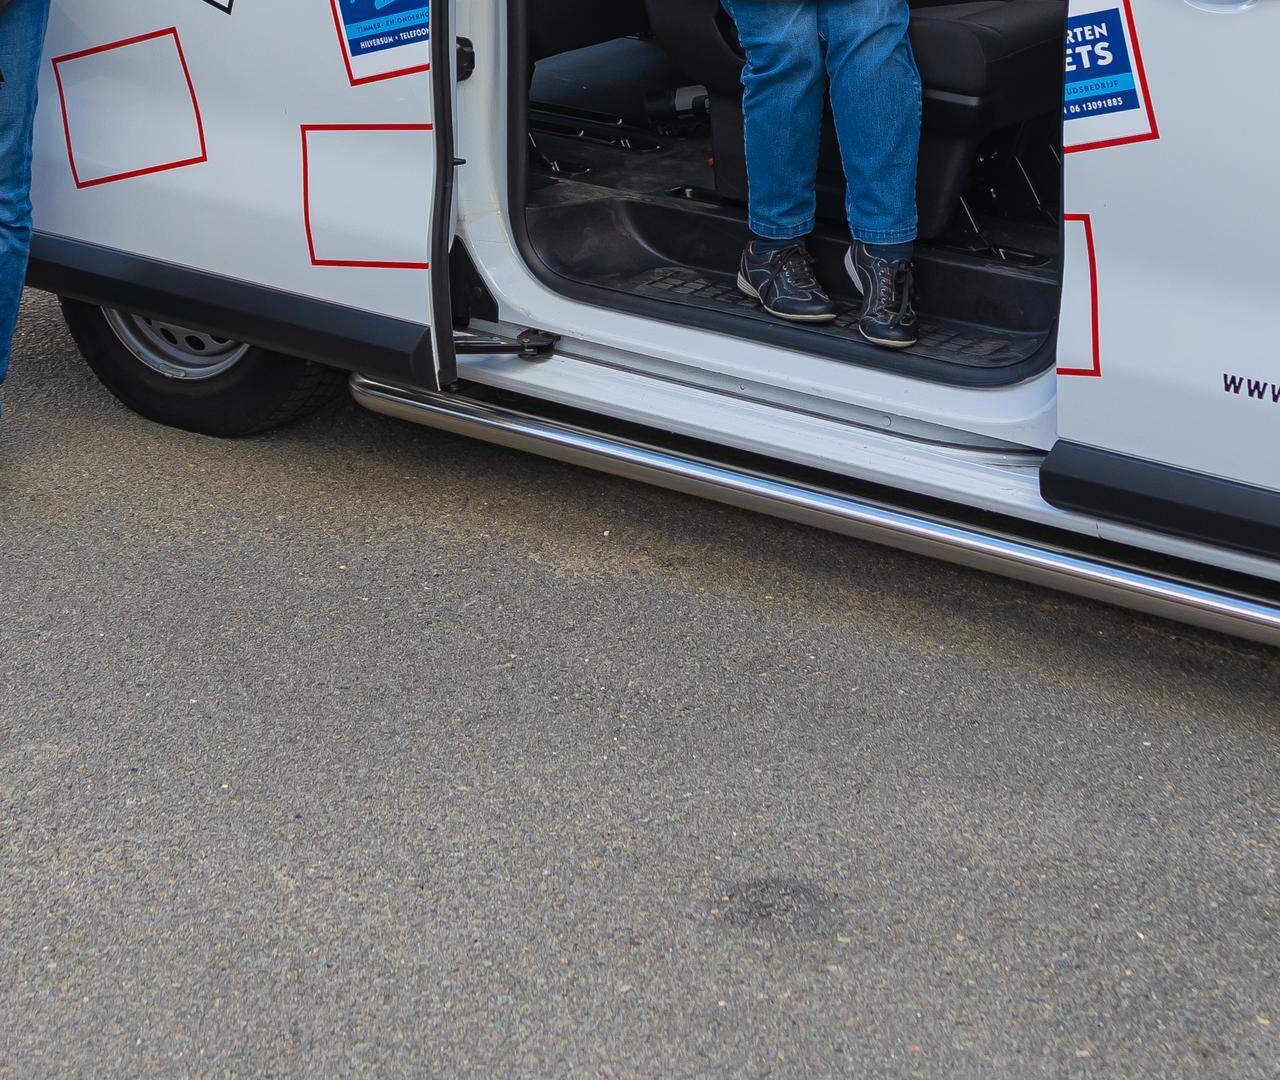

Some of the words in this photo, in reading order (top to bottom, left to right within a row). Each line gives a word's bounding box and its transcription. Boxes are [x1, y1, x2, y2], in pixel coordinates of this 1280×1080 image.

[360, 35, 394, 49] HILVERSUM
[1065, 41, 1114, 72] ETS
[1070, 104, 1081, 114] 06
[1083, 96, 1124, 112] 13091885
